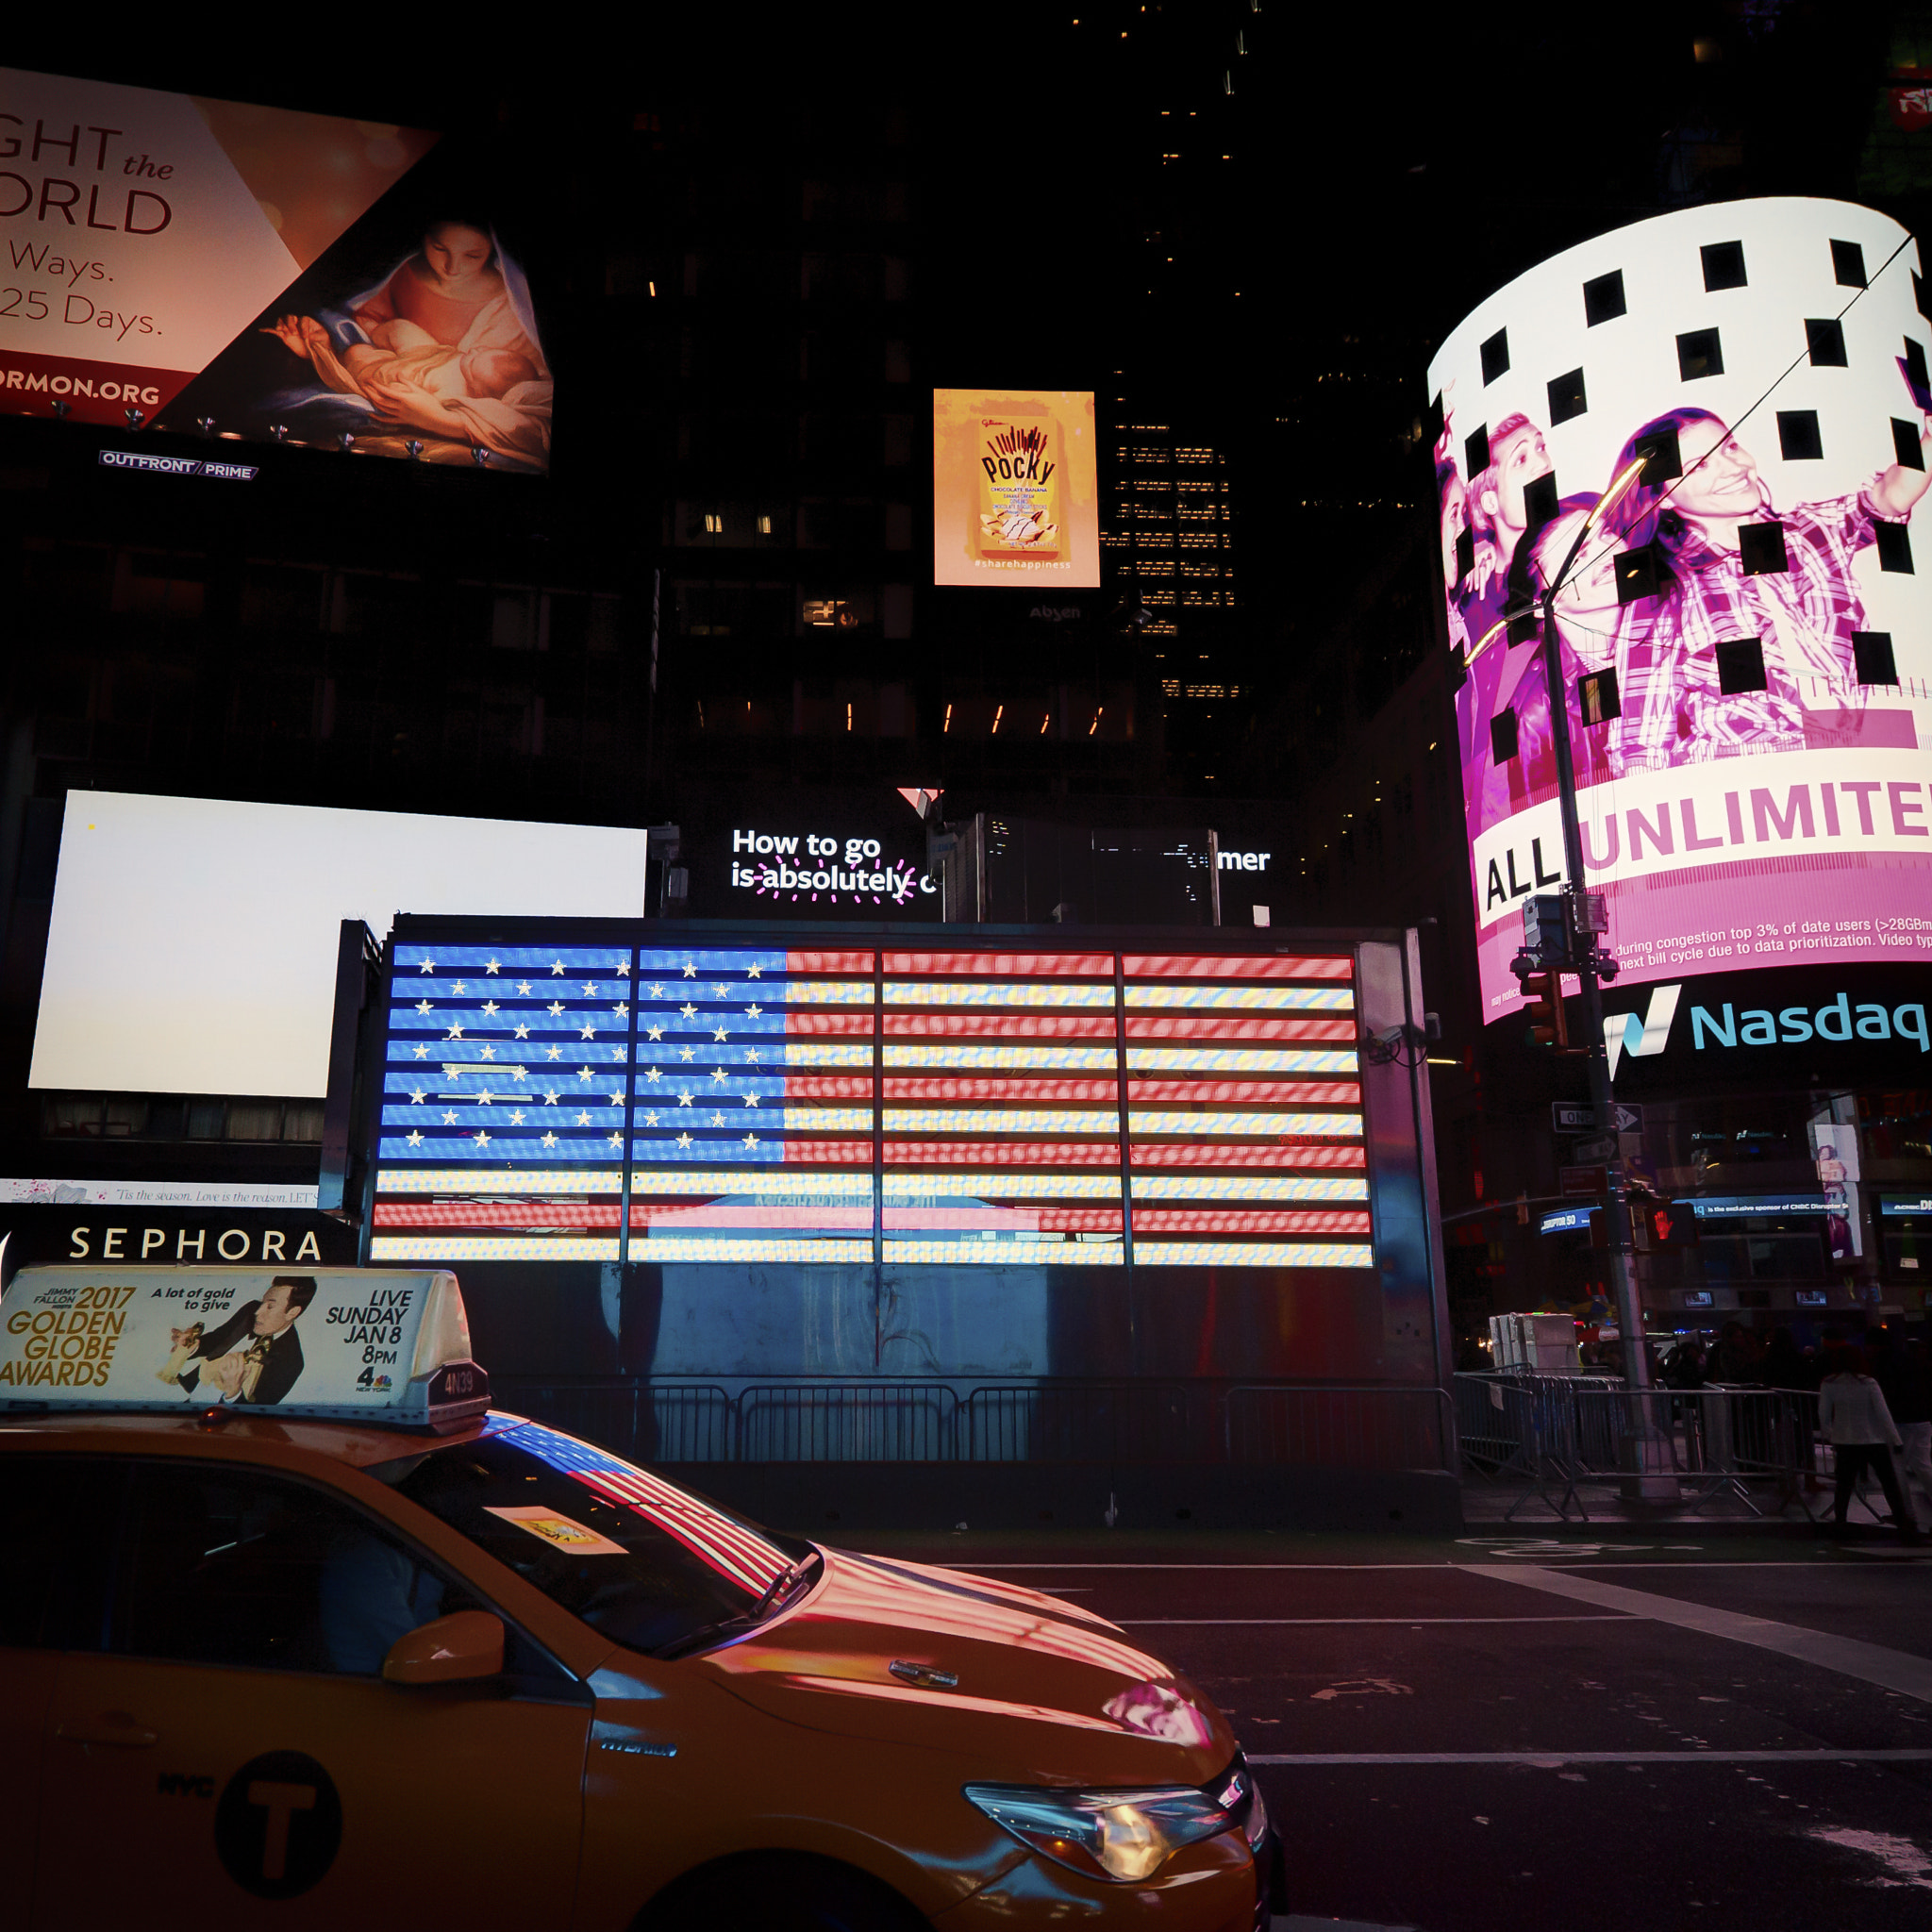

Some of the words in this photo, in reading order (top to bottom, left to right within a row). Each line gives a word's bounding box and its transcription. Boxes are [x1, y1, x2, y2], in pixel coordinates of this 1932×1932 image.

[123, 154, 174, 180] the
[9, 240, 113, 288] Ways.
[0, 288, 48, 320] 25
[64, 294, 162, 341] Days.
[0, 370, 159, 405] RMON.ORG
[103, 452, 195, 473] OUTFRONT
[205, 463, 252, 479] PRIME
[974, 559, 1071, 570] #sharehappiness
[733, 829, 799, 855] How
[807, 834, 838, 857] to
[844, 839, 881, 864] go
[1487, 837, 1561, 911] ALL
[1579, 781, 1932, 871] UNLIMITE
[732, 861, 755, 887] is
[762, 863, 910, 899] absolutely
[1615, 941, 1653, 957] during
[1657, 930, 1726, 950] congestion
[1730, 927, 1752, 941] top
[1757, 924, 1779, 937] 3%
[1783, 922, 1796, 935] of
[1801, 921, 1831, 933] date
[1835, 920, 1872, 932] users
[1620, 957, 1644, 971] next
[1648, 951, 1667, 966] bill
[1670, 948, 1704, 964] cycle
[1707, 944, 1733, 958] due
[1736, 941, 1751, 955] to
[1755, 938, 1785, 953] data
[1789, 935, 1876, 952] prioritization.
[1878, 933, 1913, 946] Video
[1690, 992, 1930, 1053] Nasdaq
[136, 1190, 154, 1200] the
[156, 1192, 192, 1202] season.
[196, 1191, 220, 1202] Love
[222, 1191, 231, 1202] is
[234, 1191, 252, 1203] the
[253, 1193, 288, 1204] reason.
[69, 1226, 322, 1261] SEPHORA
[33, 1295, 76, 1304] FALLON
[44, 1288, 79, 1296] JIMMY
[75, 1287, 137, 1309] 2017
[151, 1288, 162, 1298] A
[164, 1288, 185, 1298] lot
[188, 1288, 203, 1298] of
[203, 1288, 236, 1300] gold
[184, 1299, 199, 1310] to
[201, 1300, 230, 1313] give
[369, 1290, 414, 1307] LIVE
[7, 1310, 127, 1335] GOLDEN
[325, 1307, 409, 1324] SUNDAY
[343, 1325, 387, 1343] JAN
[389, 1326, 402, 1344] 8
[24, 1335, 119, 1360] GLOBE
[362, 1345, 397, 1364] 8PM
[0, 1360, 111, 1387] AWARDS
[357, 1366, 375, 1387] 4
[444, 1371, 473, 1395] 4N39
[158, 1773, 214, 1798] NYC
[247, 1779, 317, 1880] T
